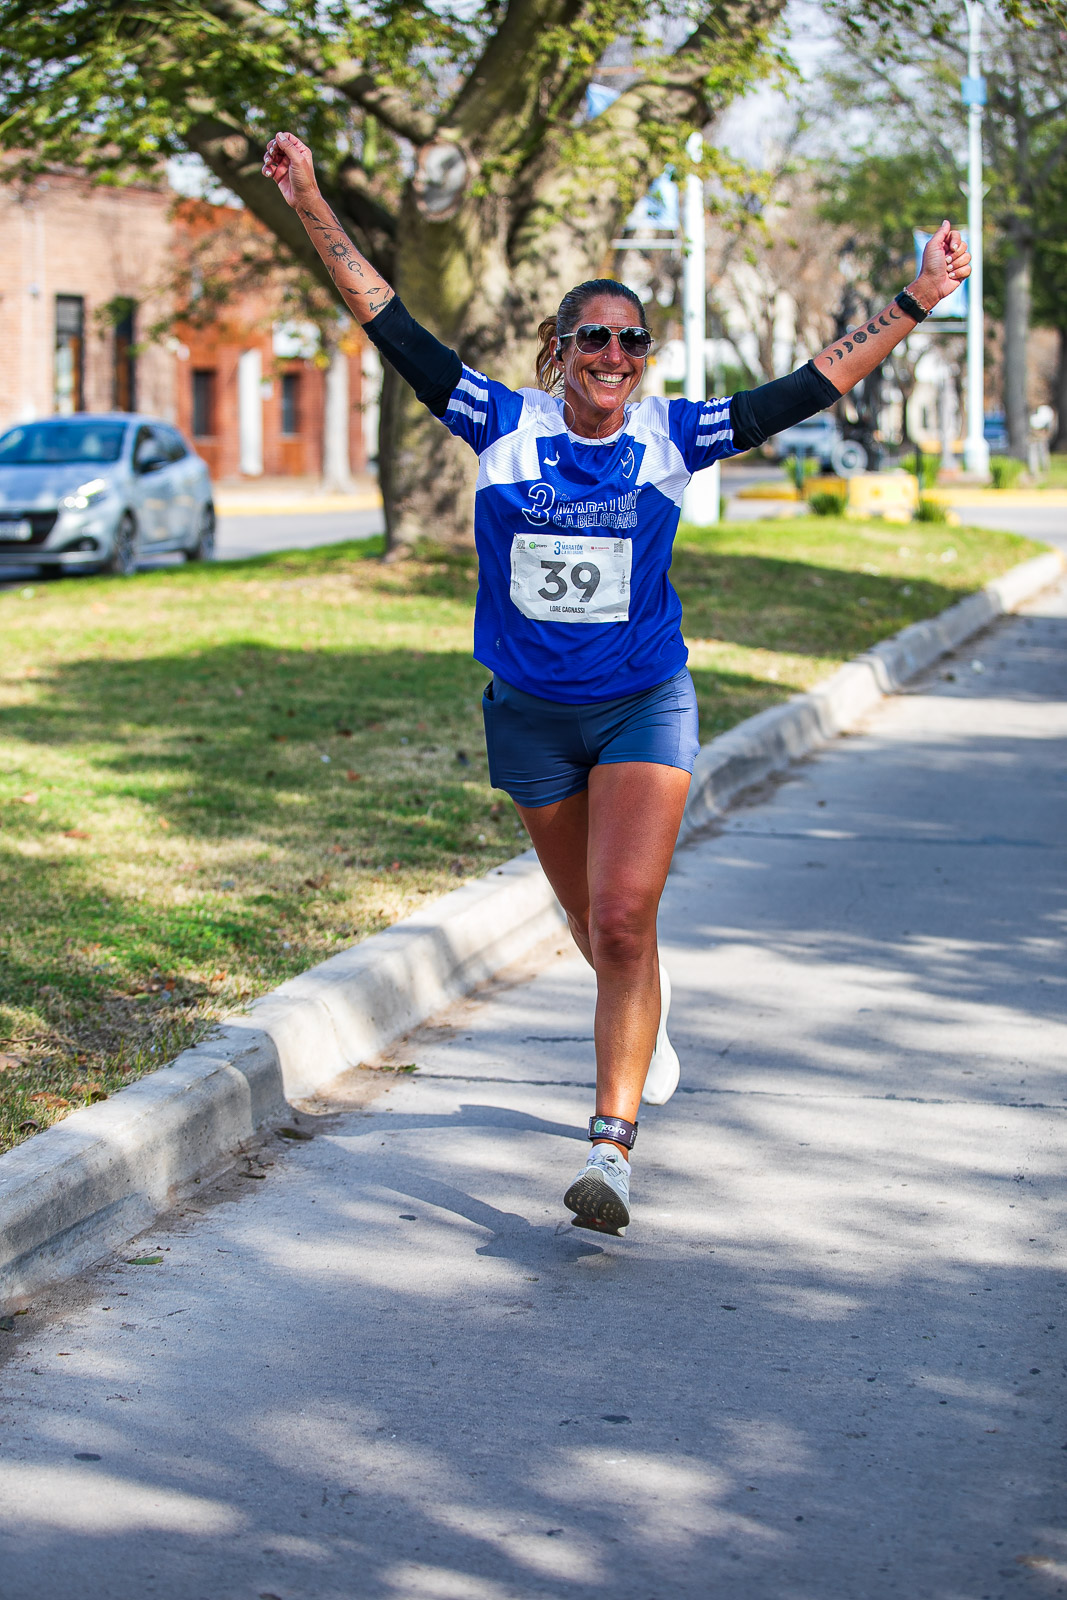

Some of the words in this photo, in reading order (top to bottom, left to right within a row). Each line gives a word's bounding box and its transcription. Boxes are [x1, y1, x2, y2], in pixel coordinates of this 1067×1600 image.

[522, 483, 556, 526] 3
[554, 540, 561, 555] 3
[538, 560, 601, 603] 39
[550, 605, 561, 613] LORE
